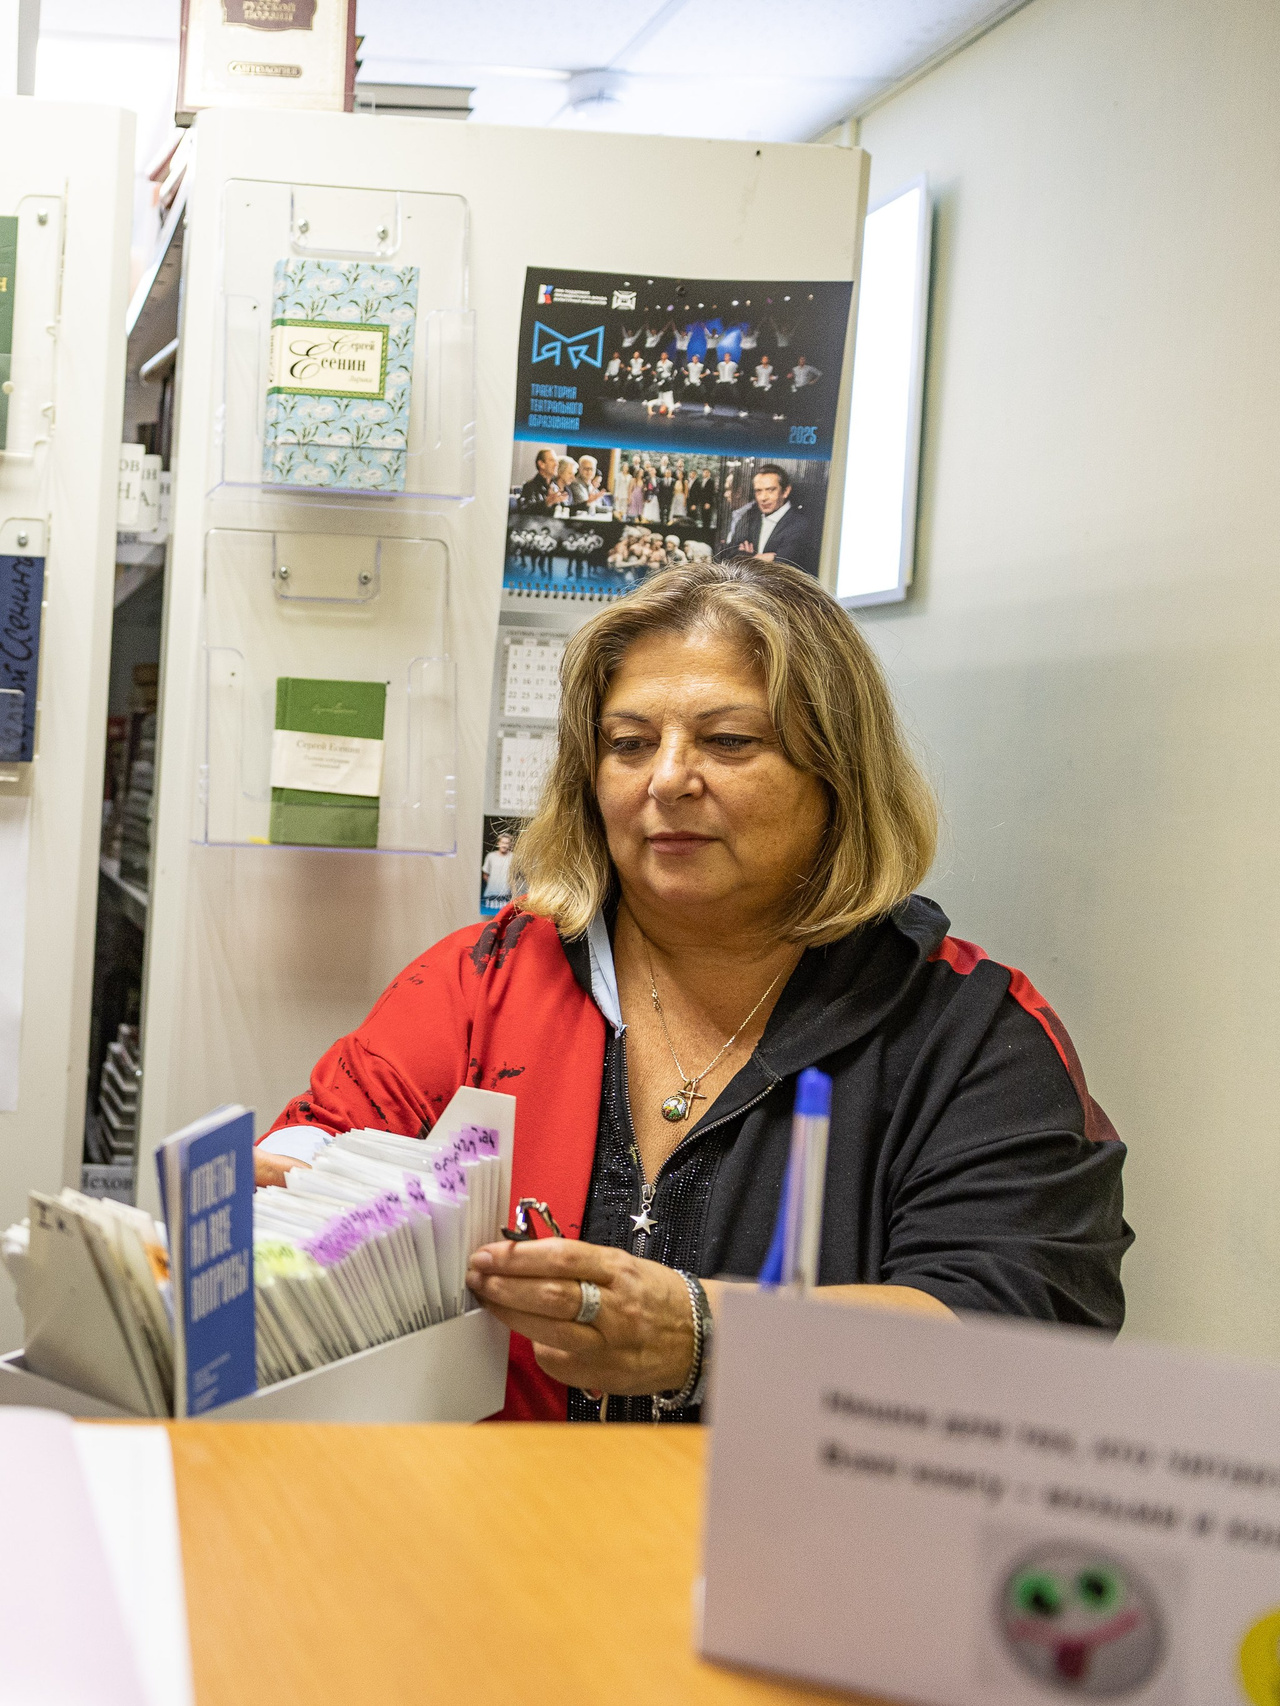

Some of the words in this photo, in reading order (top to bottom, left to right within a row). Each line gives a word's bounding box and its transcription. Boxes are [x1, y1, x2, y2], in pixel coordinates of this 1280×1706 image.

[328, 331, 376, 354] Сергей
[289, 339, 366, 381] Есенин
[789, 425, 819, 445] 2025
